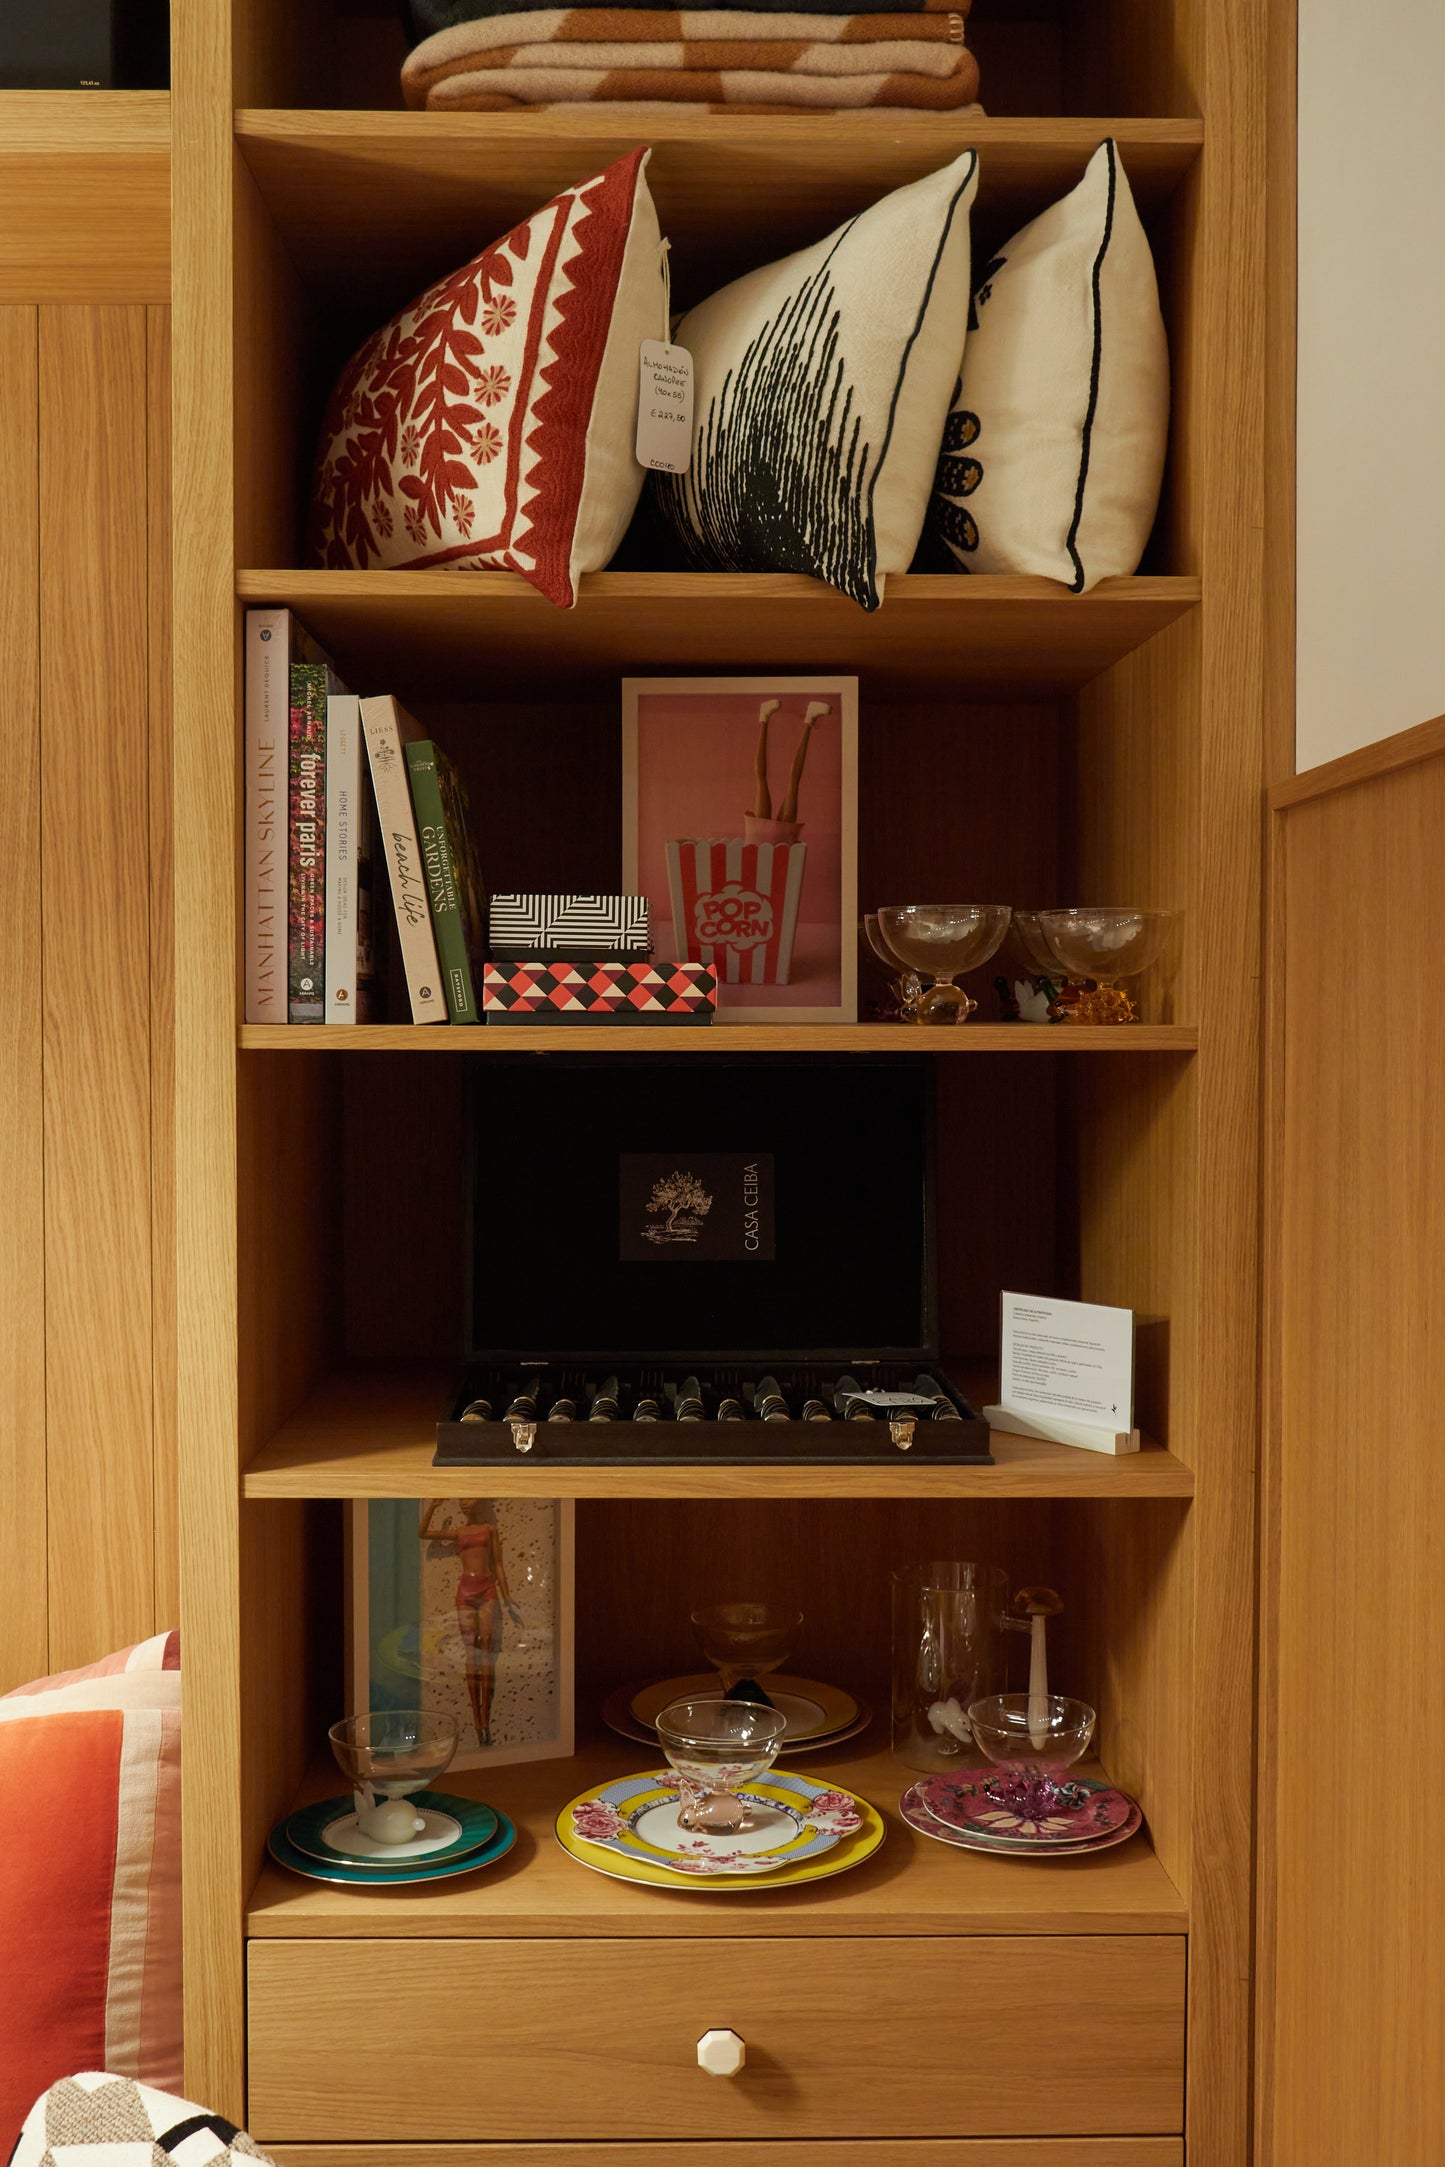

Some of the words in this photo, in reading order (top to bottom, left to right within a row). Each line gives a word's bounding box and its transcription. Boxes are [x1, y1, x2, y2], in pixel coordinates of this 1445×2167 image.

[370, 726, 393, 735] LIESS
[258, 738, 275, 841] SKYLINE
[300, 753, 321, 818] forever
[338, 791, 347, 816] HOME
[296, 822, 321, 867] paris
[338, 821, 347, 861] STORIES
[392, 832, 421, 889] beach
[422, 826, 448, 913] GARDENS
[436, 826, 456, 910] UNFORGETTABLE
[258, 850, 274, 1005] MANHATTAN
[398, 894, 425, 927] life
[700, 918, 770, 938] CORN
[703, 898, 761, 920] POP
[743, 1163, 758, 1206] CEIBA
[744, 1209, 759, 1251] CASA
